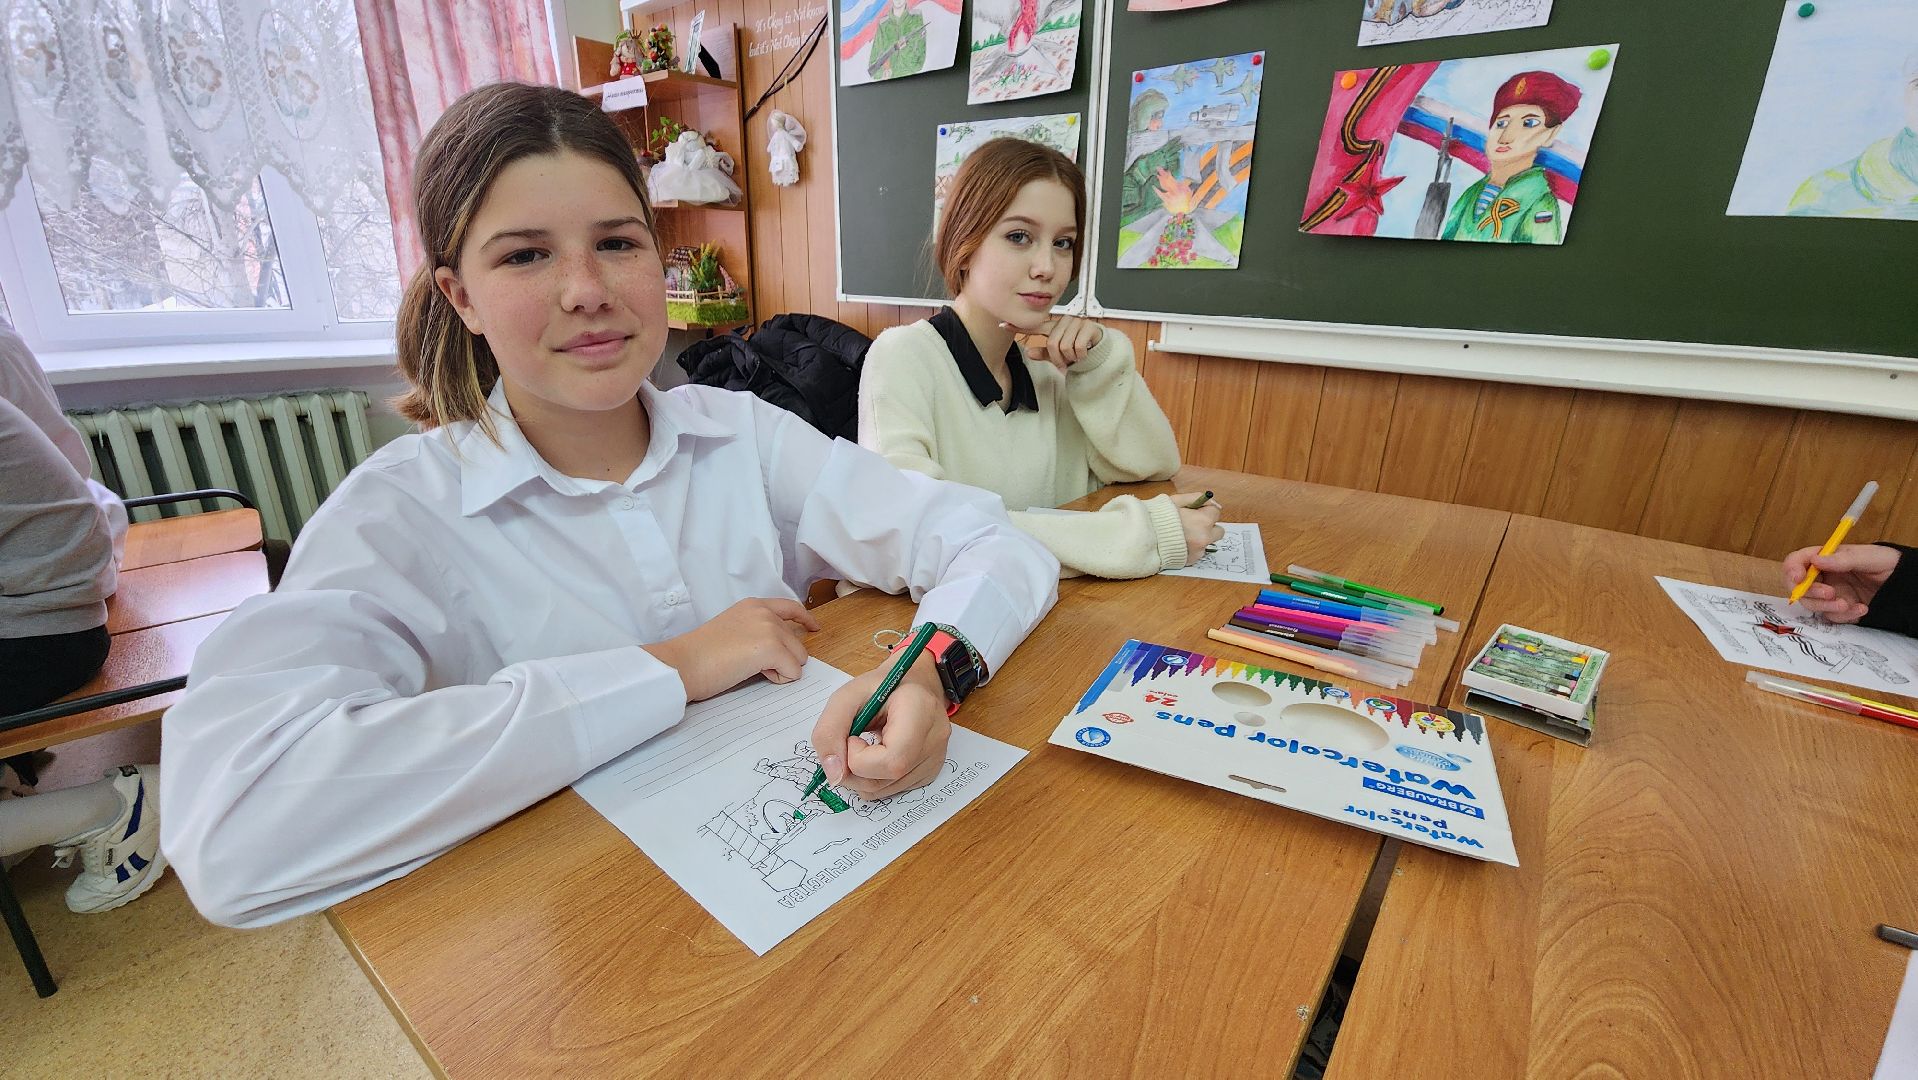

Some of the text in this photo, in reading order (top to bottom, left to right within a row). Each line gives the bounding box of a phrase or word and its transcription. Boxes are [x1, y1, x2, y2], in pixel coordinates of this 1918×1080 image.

[1145, 694, 1178, 707] 24
[1246, 731, 1477, 801] watercolor
[1376, 782, 1456, 810] BRAUBERG
[1343, 804, 1485, 849] watercolor
[777, 847, 868, 908] ОТЕЧЕСТВА
